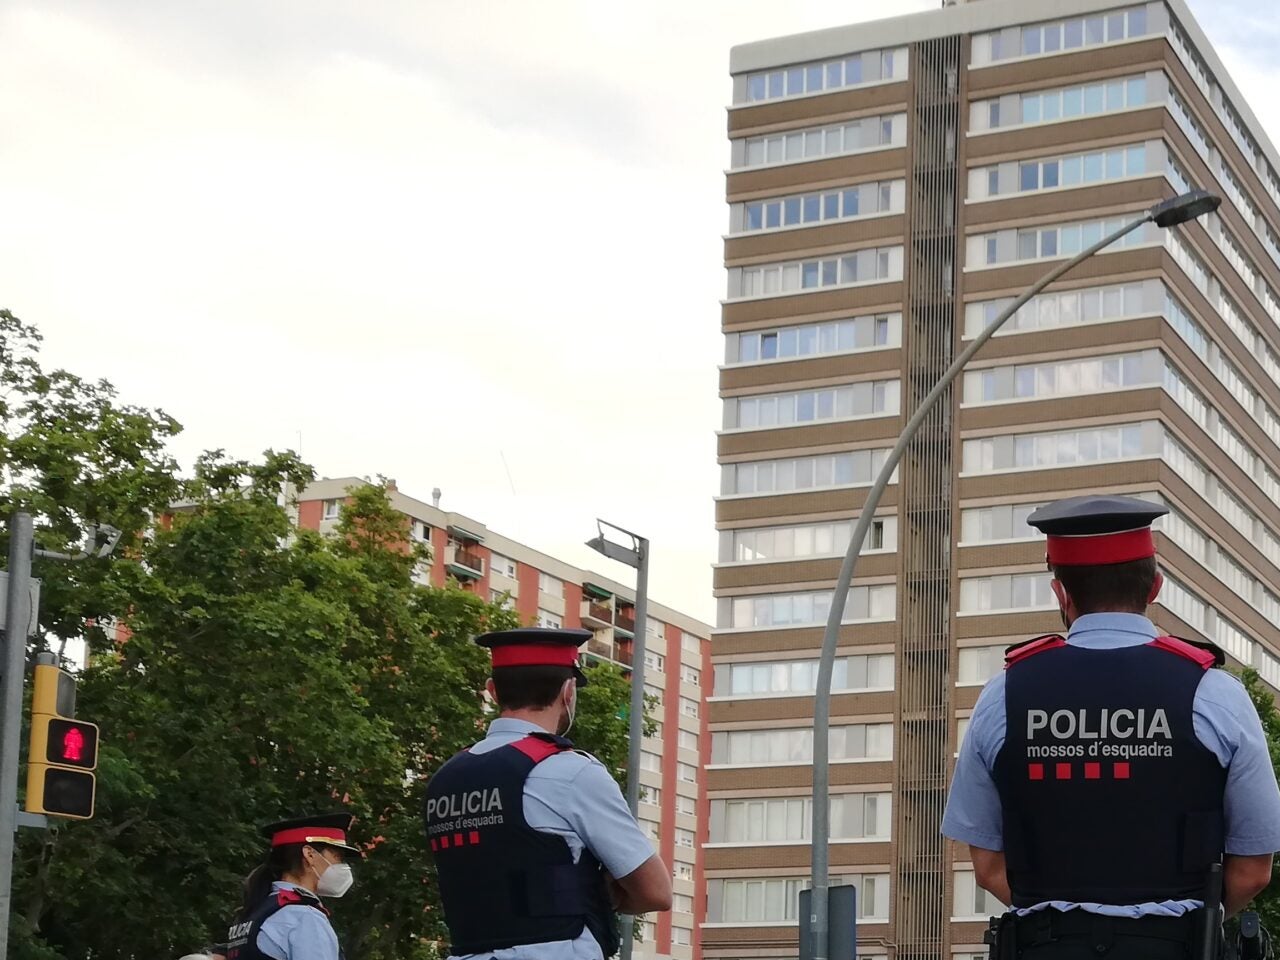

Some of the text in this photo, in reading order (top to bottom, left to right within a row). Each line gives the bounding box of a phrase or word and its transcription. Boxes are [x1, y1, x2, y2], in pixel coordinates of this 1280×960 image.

[1027, 708, 1173, 740] POLICIA
[1027, 744, 1085, 758] mossos
[427, 787, 503, 823] POLICIA
